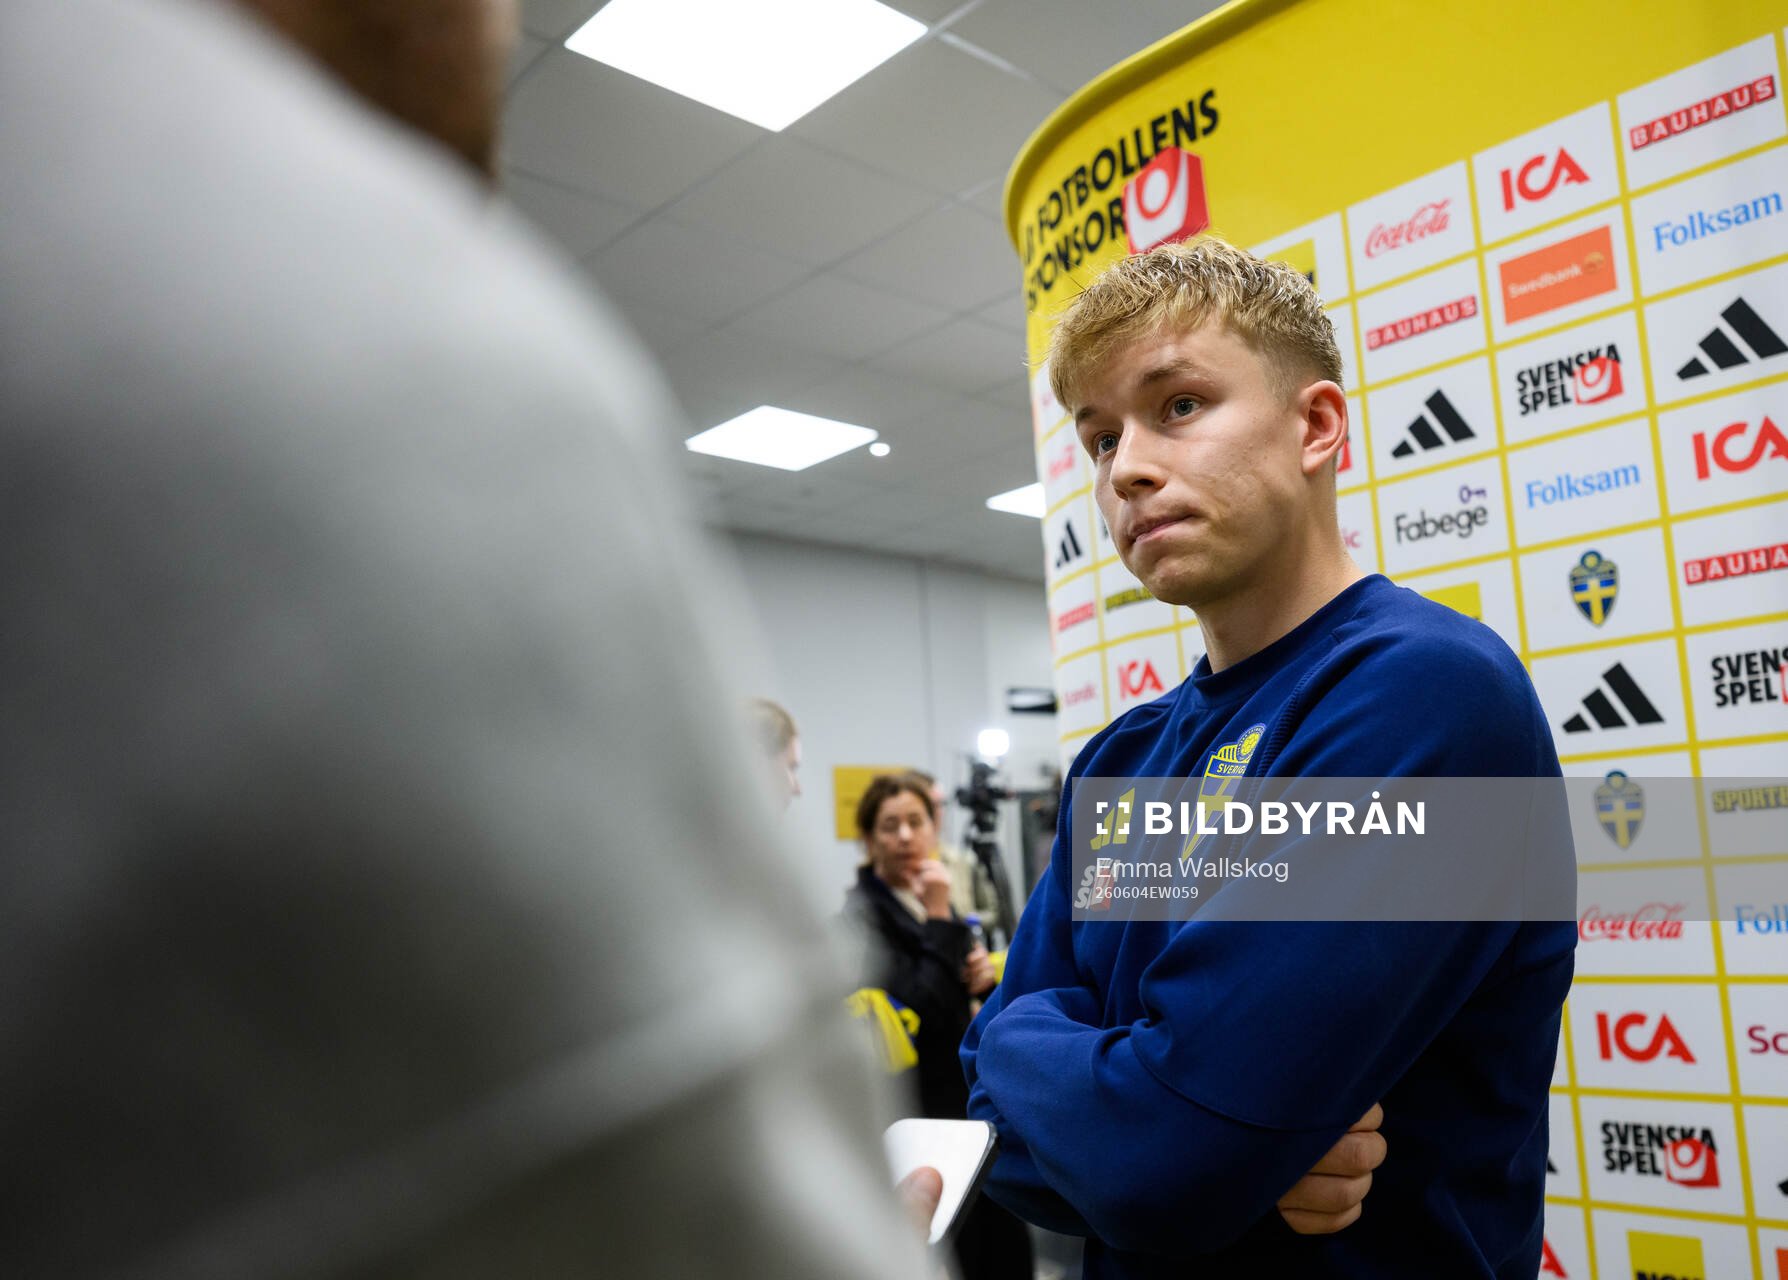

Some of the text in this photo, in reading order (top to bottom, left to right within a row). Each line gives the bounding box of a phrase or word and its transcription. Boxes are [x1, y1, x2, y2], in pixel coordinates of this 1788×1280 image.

[1629, 75, 1776, 151] BAUHAUS
[1038, 88, 1220, 242] FOTBOLLENS
[1499, 147, 1591, 213] ICA
[1652, 191, 1785, 253] Folksam
[1508, 263, 1582, 298] Swedbank
[1366, 296, 1477, 350] BAUHAUS
[1519, 384, 1572, 416] SPEL
[1691, 416, 1788, 481] ICA
[1524, 464, 1641, 510] Folksam
[1396, 505, 1488, 544] Fabege
[1118, 660, 1165, 700] ICA
[1714, 677, 1778, 708] SPEL
[1735, 904, 1788, 936] Fol
[1596, 1012, 1697, 1064] ICA
[1604, 1148, 1662, 1177] SPEL
